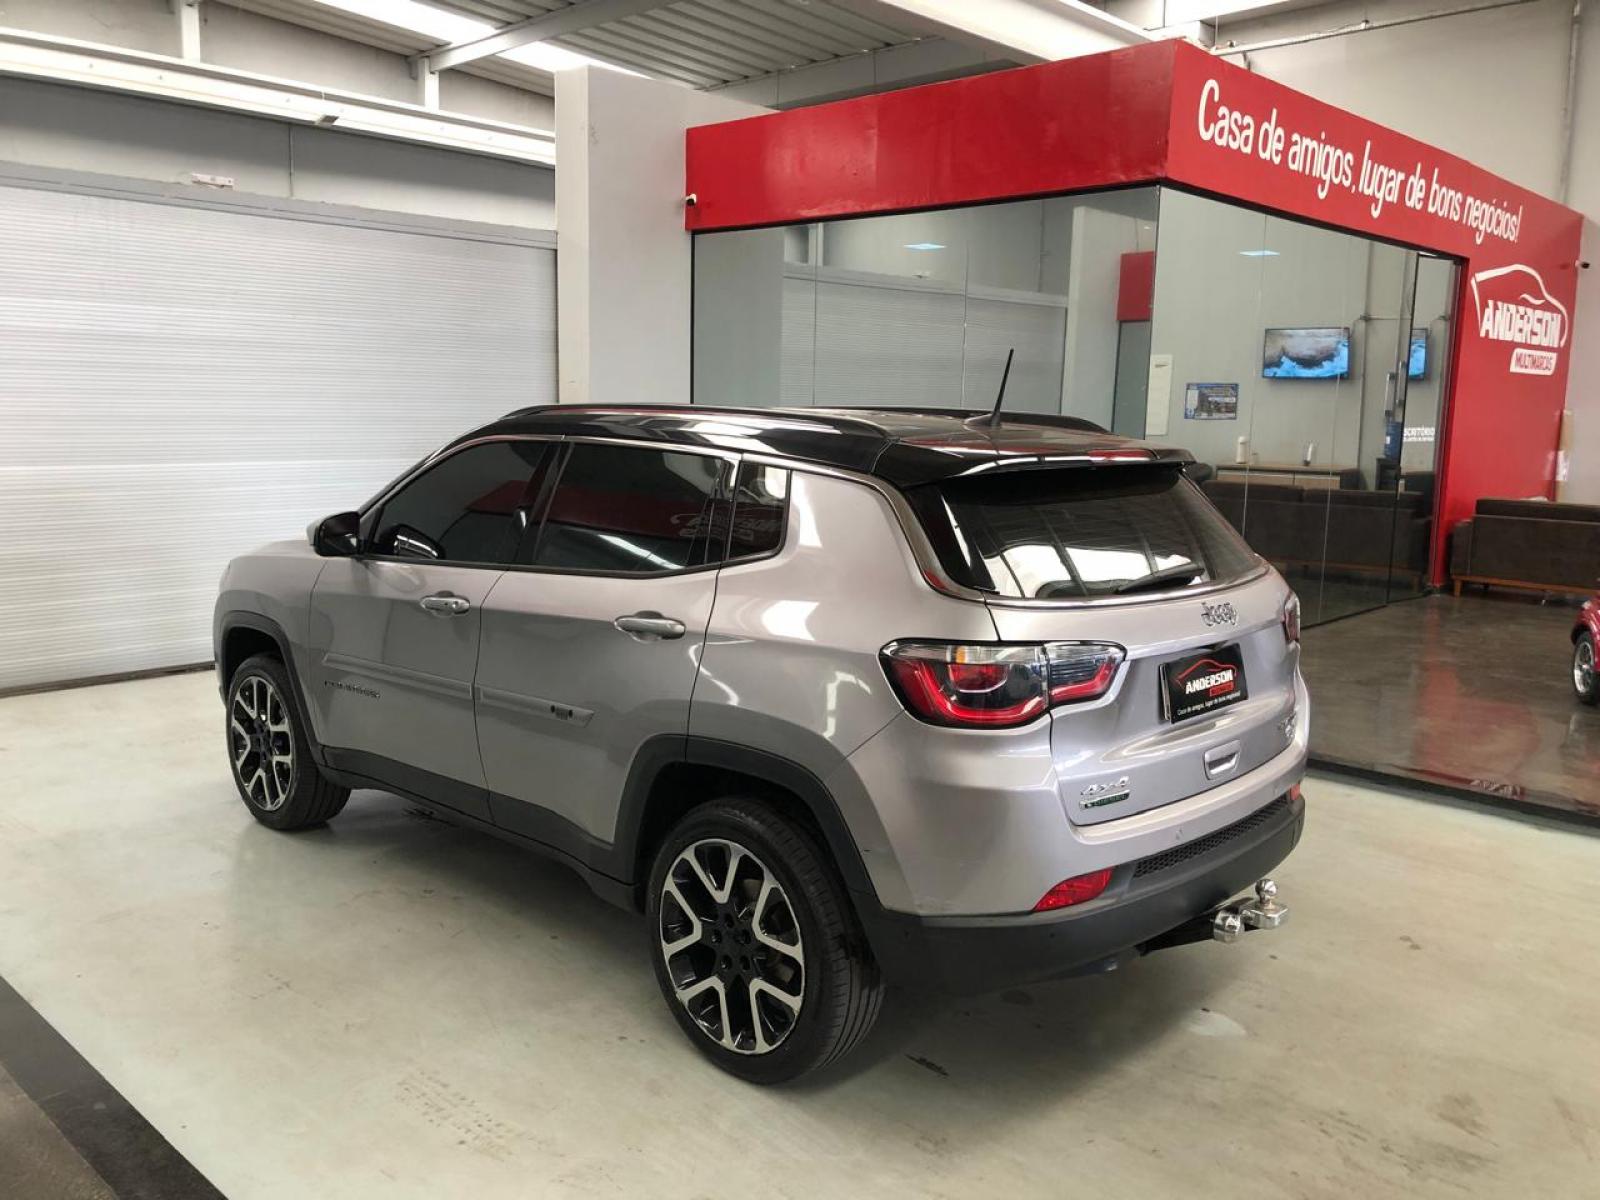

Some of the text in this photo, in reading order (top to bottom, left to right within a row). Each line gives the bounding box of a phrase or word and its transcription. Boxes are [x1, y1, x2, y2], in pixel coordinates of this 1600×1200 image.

[1198, 79, 1523, 245] Casa de amigos, lugar de bons negócios!
[1480, 299, 1562, 348] ANDERSON
[1185, 669, 1234, 695] ANDERSON
